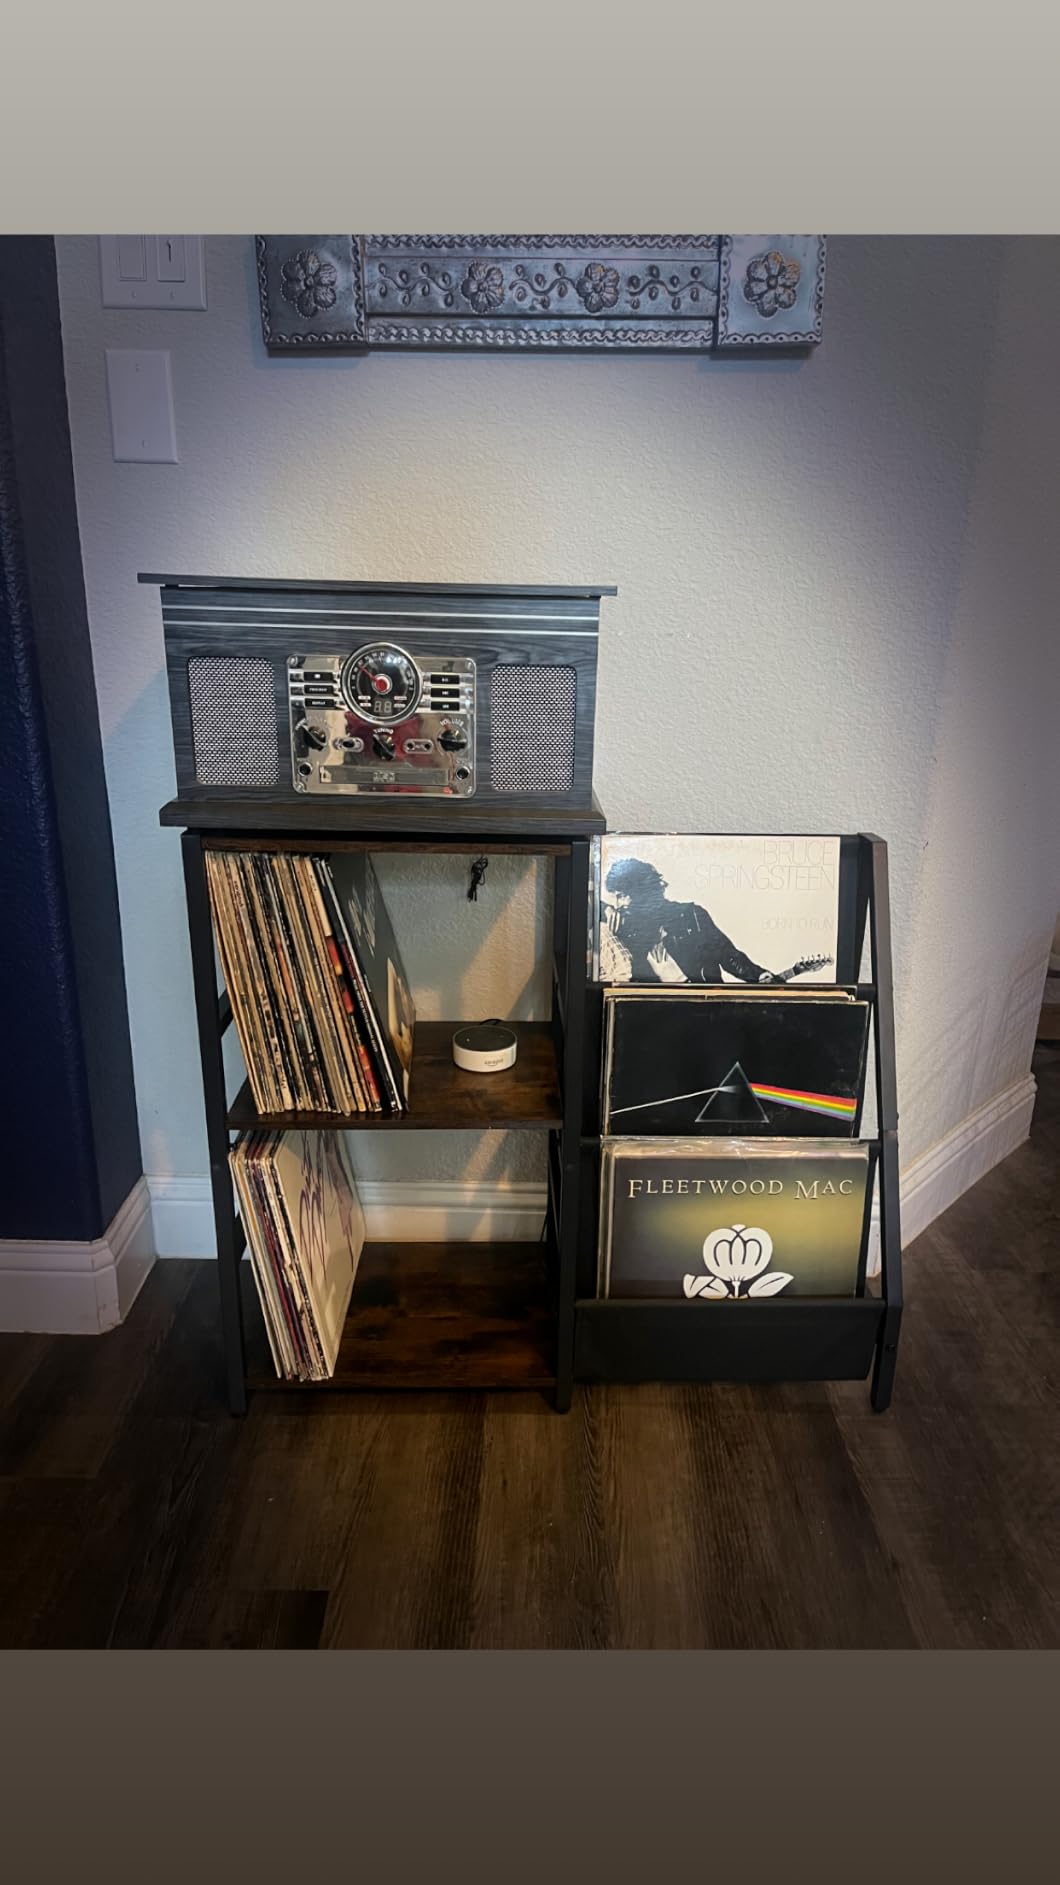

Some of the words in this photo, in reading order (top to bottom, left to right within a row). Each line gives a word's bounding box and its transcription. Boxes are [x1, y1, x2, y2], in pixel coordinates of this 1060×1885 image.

[763, 840, 835, 865] BRUCE
[694, 864, 836, 891] SPRINGSTEEN
[627, 1179, 784, 1199] FLEETWOOD
